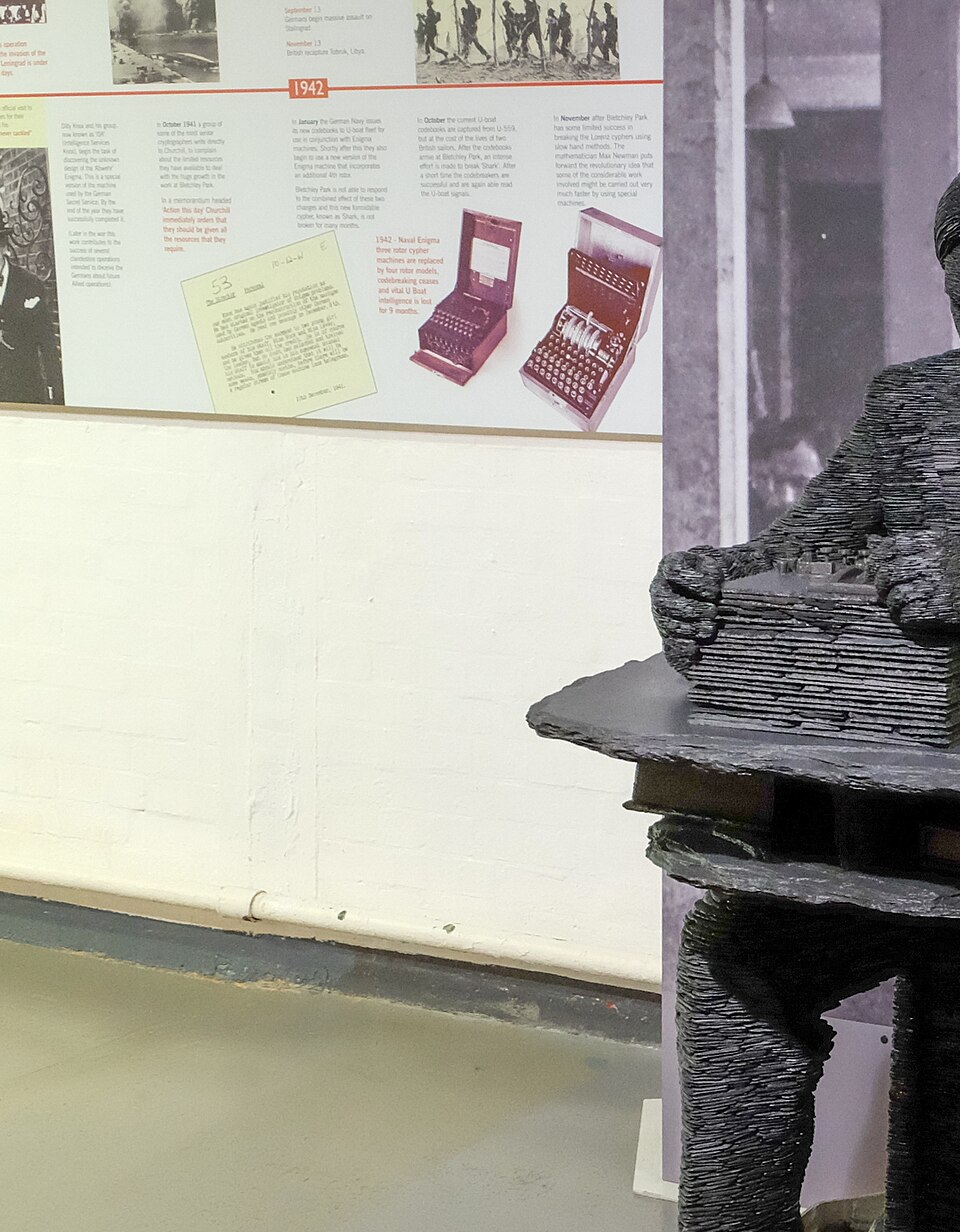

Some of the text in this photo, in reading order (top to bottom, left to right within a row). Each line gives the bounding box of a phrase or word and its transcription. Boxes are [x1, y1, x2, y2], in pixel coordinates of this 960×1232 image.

[294, 80, 325, 96] 1942
[606, 114, 633, 122] Bletchley
[554, 134, 579, 142] breaking
[611, 133, 634, 141] cyphers
[635, 133, 651, 141] using
[640, 152, 653, 160] puts
[589, 162, 627, 170] revolutionary
[581, 181, 598, 189] might
[591, 190, 599, 198] by
[600, 190, 616, 198] using
[617, 190, 637, 198] special
[417, 236, 440, 245] Enigma
[408, 246, 429, 255] cypher
[418, 257, 444, 266] replaced
[377, 266, 385, 275] by
[211, 275, 233, 295] 53
[378, 277, 417, 285] codebreaking
[379, 296, 413, 305] intelligence
